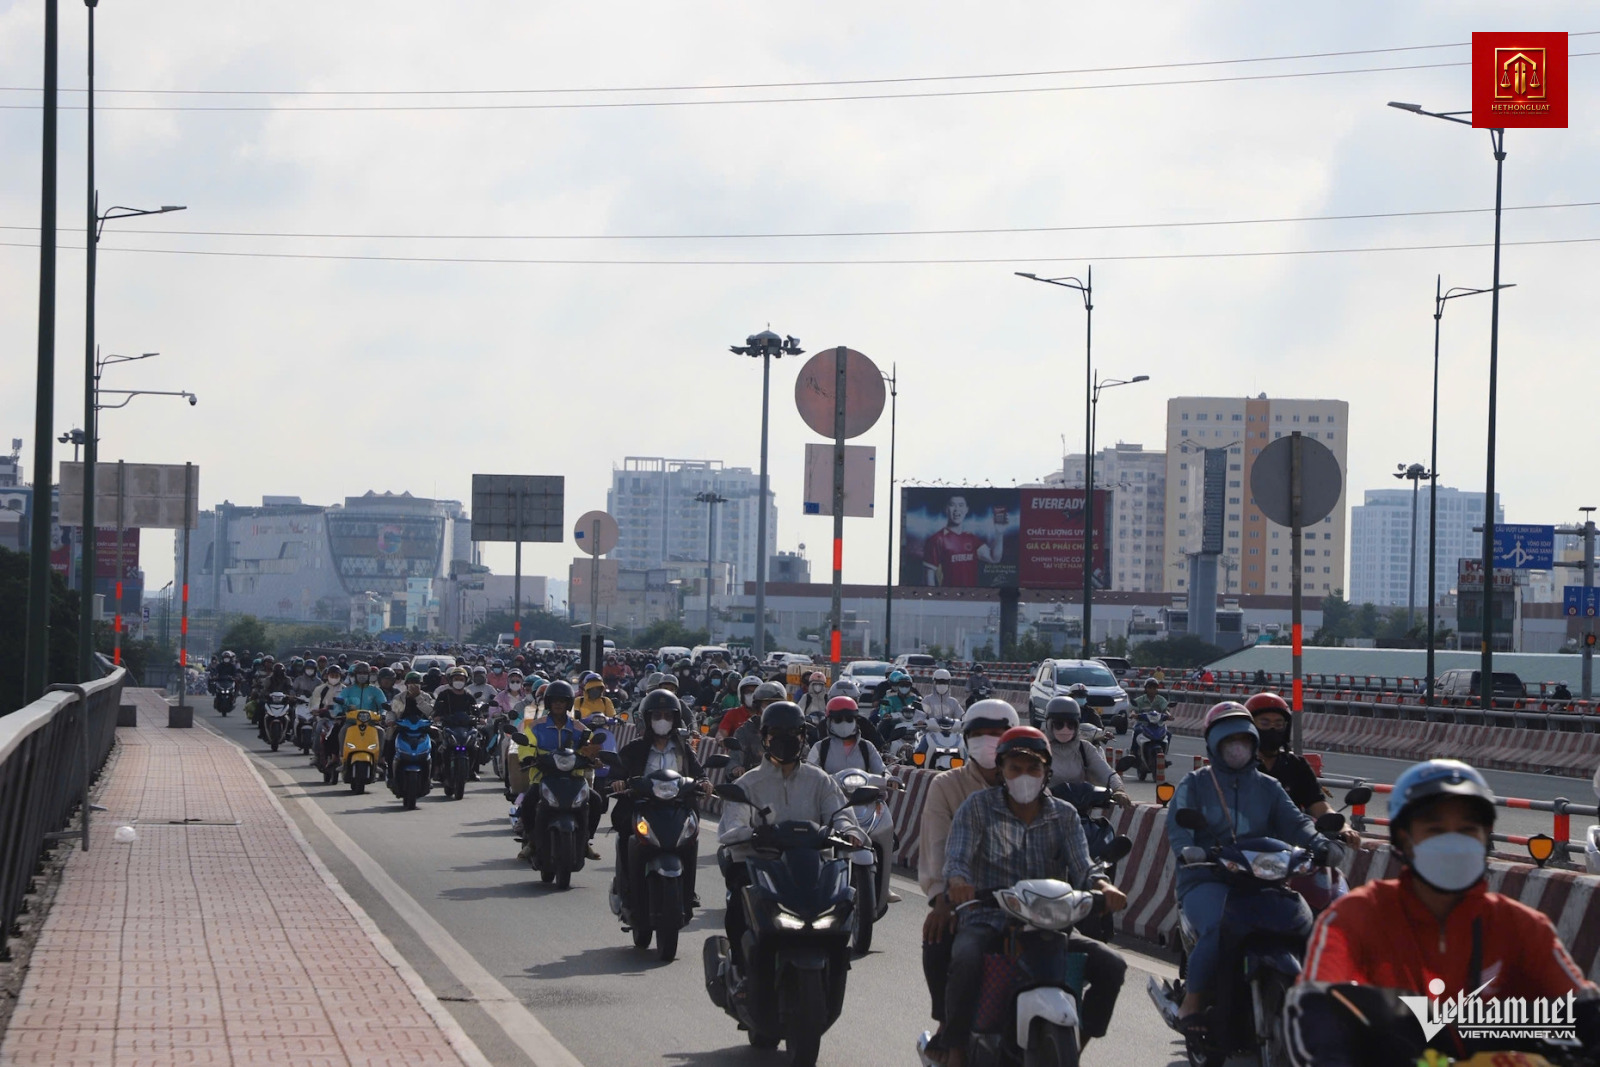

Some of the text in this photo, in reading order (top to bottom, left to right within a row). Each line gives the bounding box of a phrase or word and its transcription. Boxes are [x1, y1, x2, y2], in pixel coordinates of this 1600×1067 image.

[1031, 497, 1086, 510] EVEREADY
[1026, 527, 1046, 536] CHẤT
[1047, 528, 1073, 537] LƯỢNG
